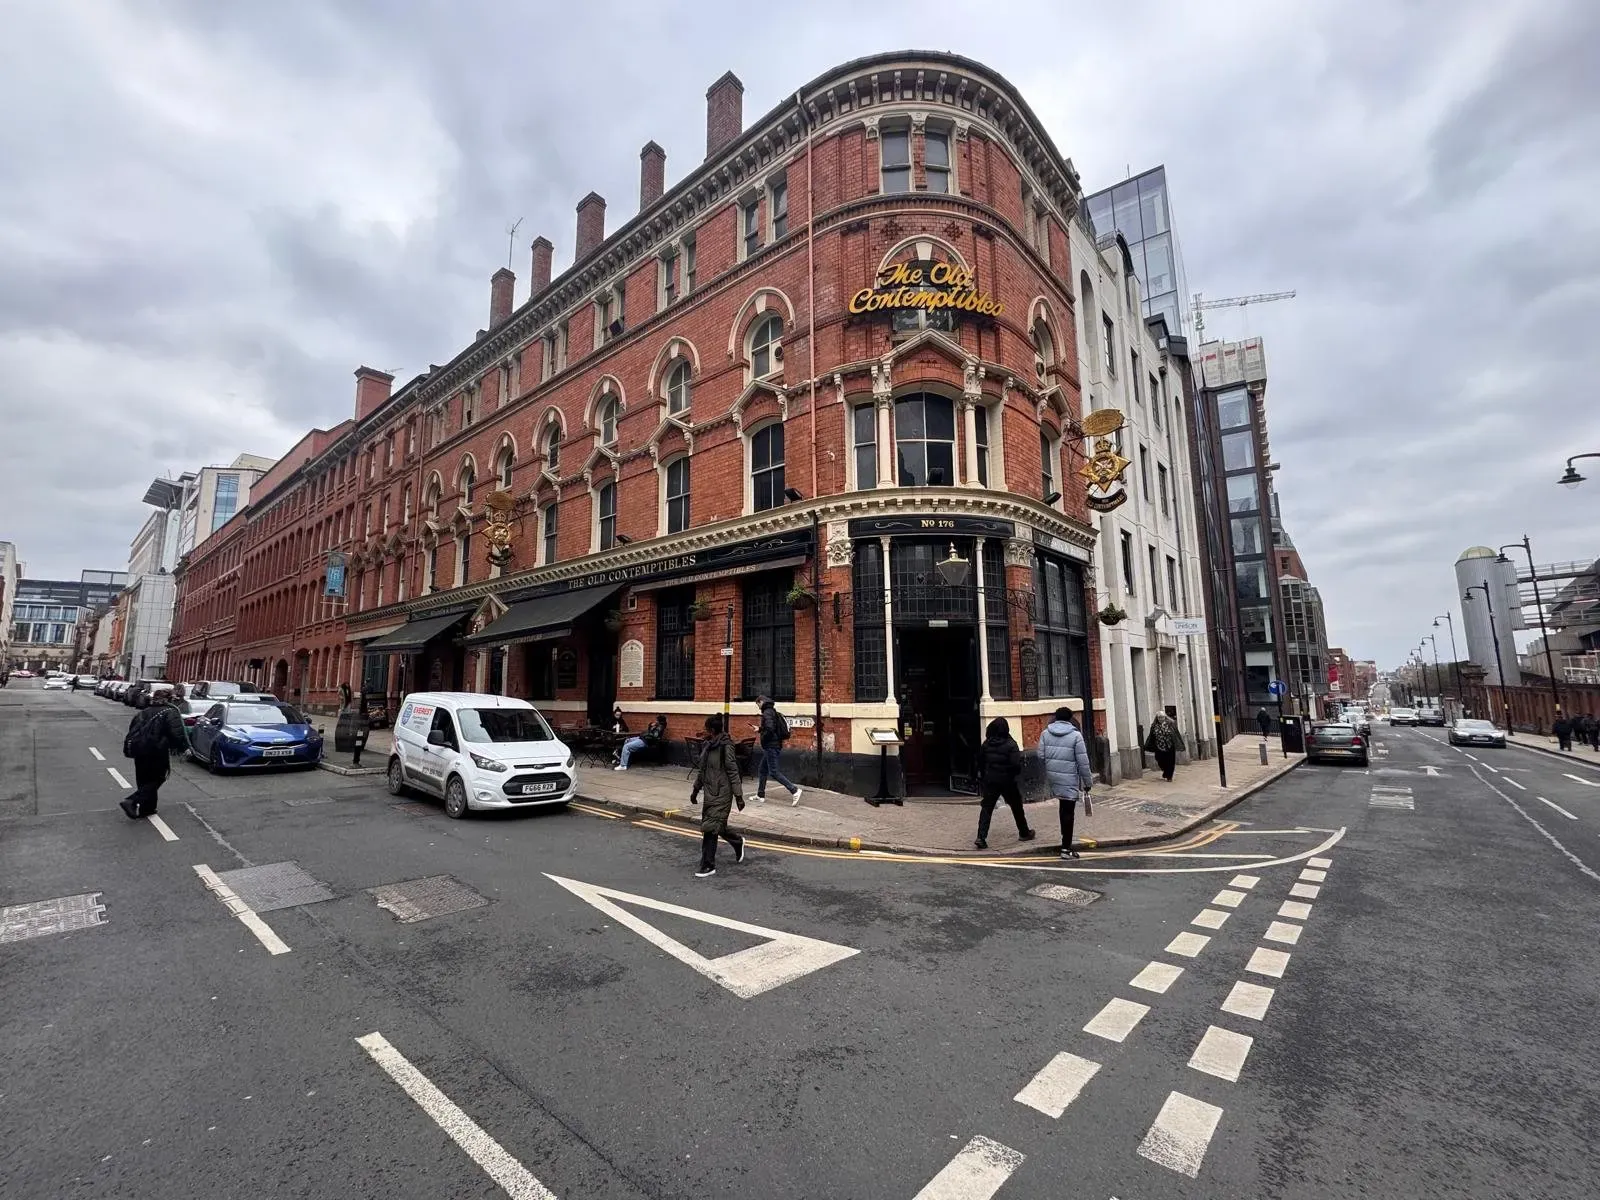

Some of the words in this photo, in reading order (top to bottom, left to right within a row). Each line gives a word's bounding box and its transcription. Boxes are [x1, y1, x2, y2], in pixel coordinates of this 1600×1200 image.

[878, 262, 923, 286] The
[930, 262, 976, 288] Old
[849, 286, 1006, 317] Contemptibles
[938, 520, 955, 528] 176
[568, 578, 585, 589] THE
[587, 574, 606, 586] OLD
[608, 554, 696, 582] CONTEMPTIBLES
[680, 575, 694, 583] OLD
[694, 564, 757, 580] CONTEMPTIBLES
[413, 706, 433, 715] EVEREST
